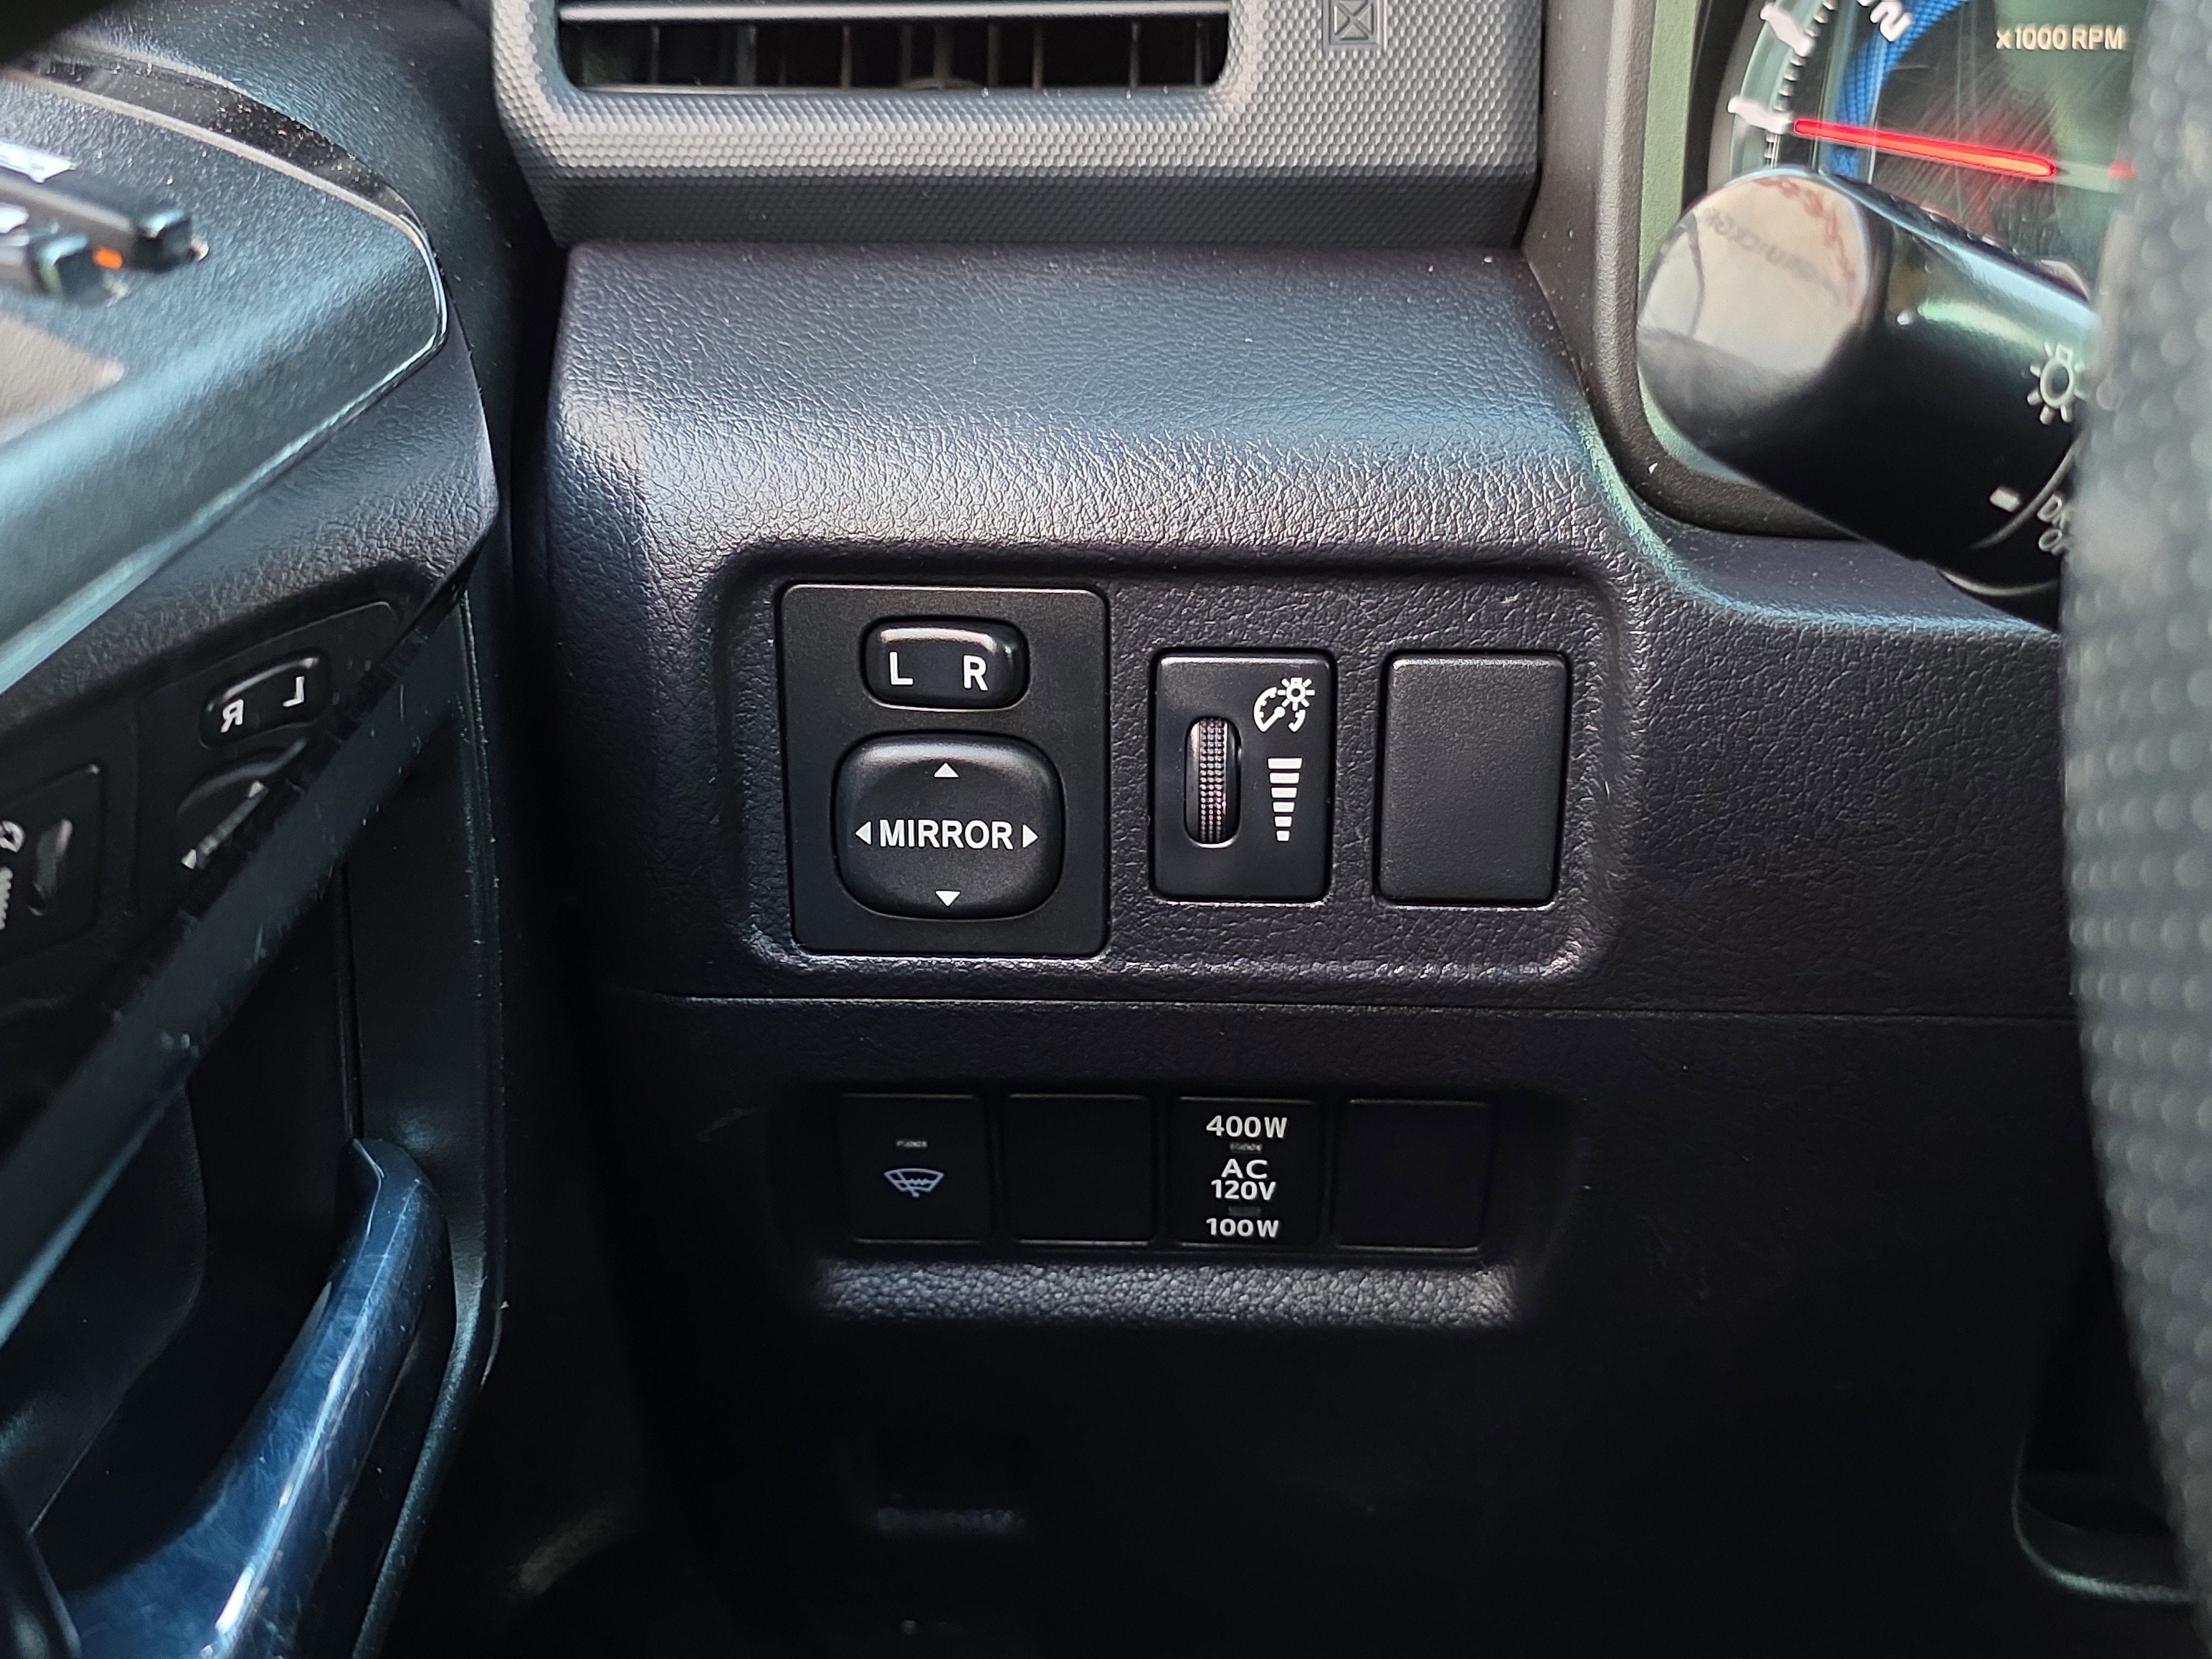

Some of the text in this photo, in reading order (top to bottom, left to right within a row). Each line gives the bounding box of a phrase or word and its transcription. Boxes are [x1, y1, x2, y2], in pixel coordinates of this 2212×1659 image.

[1869, 0, 1913, 42] 2
[2071, 23, 2125, 50] RPM
[889, 652, 989, 691] L R
[879, 819, 1014, 850] MIRROR
[1206, 1115, 1288, 1138] 400W
[1220, 1158, 1268, 1179] AC
[1211, 1179, 1276, 1201] 120V
[1206, 1218, 1279, 1238] 100W
